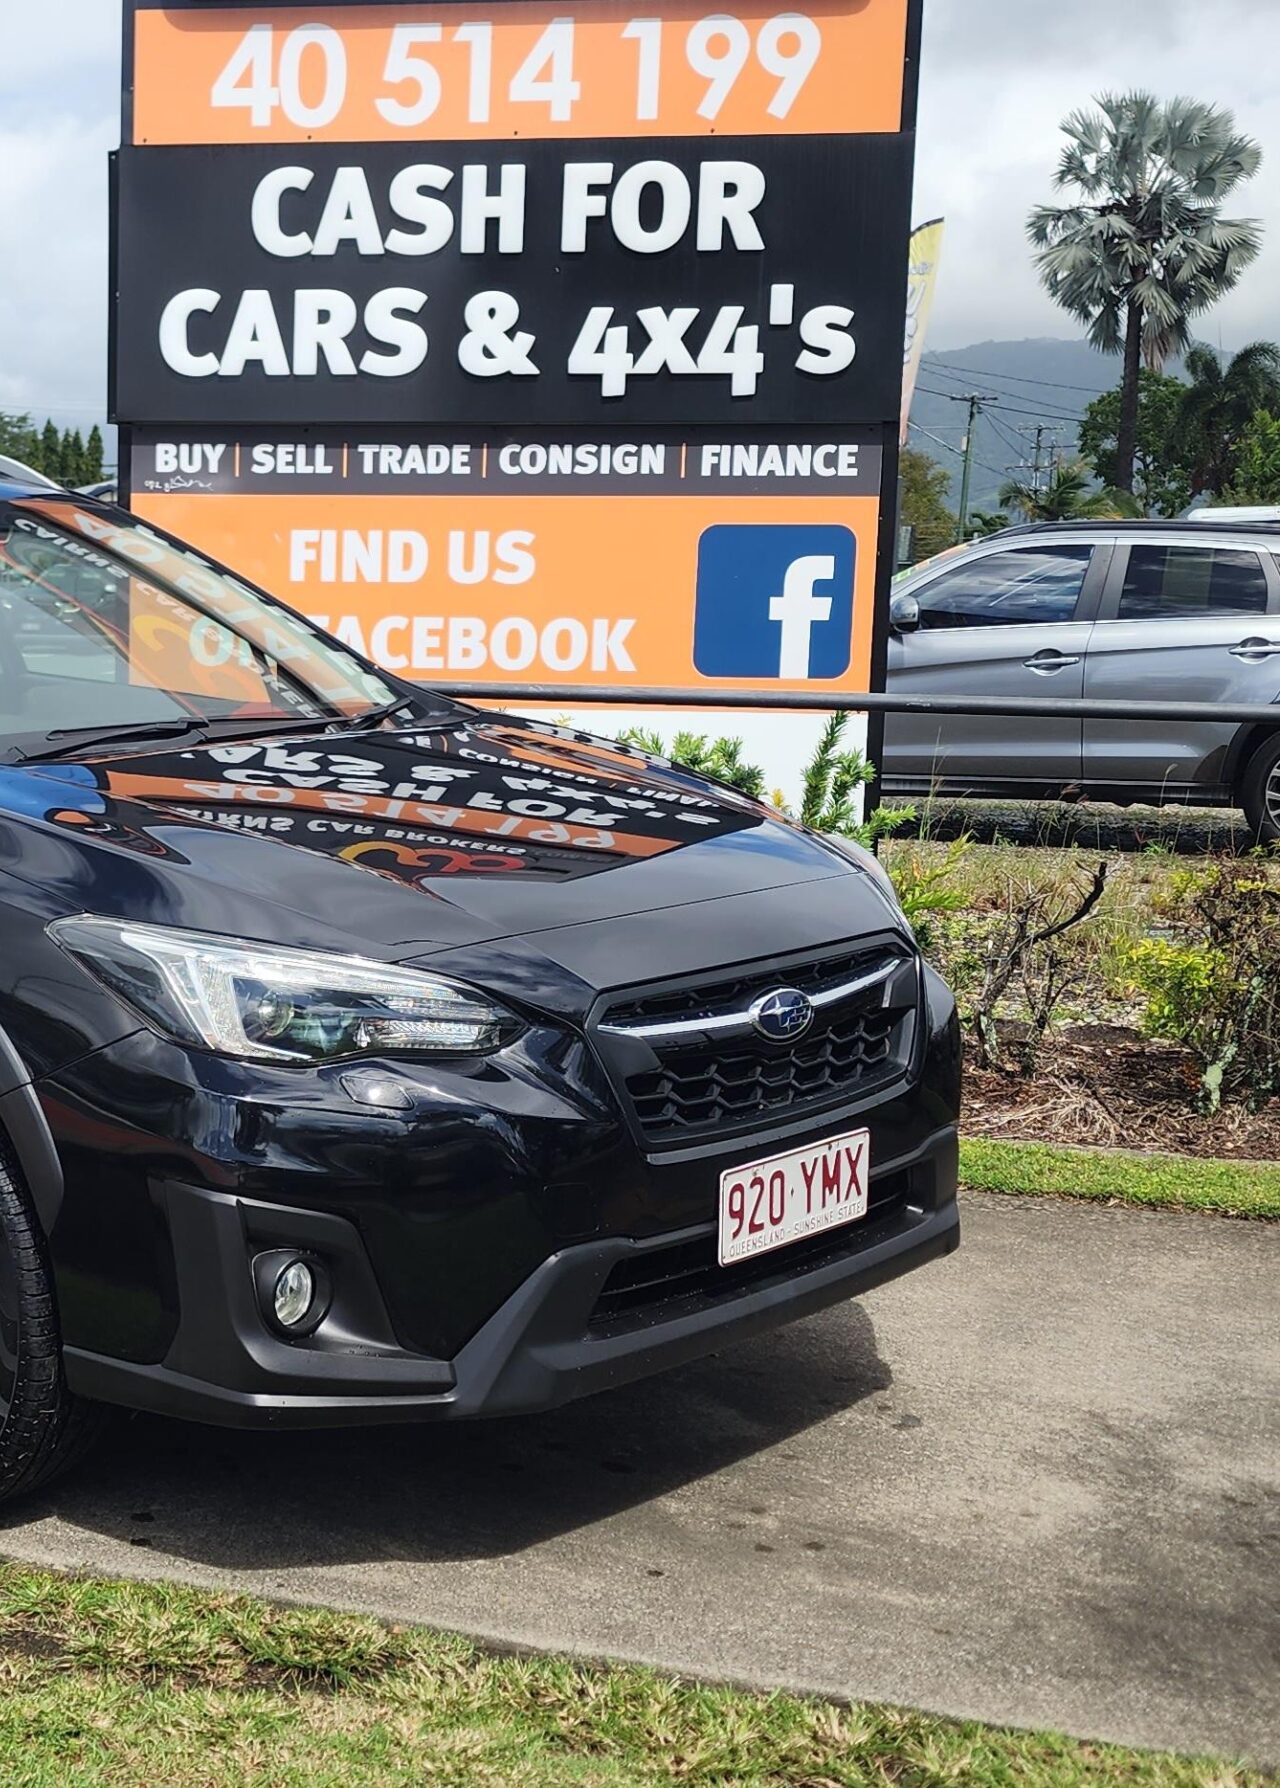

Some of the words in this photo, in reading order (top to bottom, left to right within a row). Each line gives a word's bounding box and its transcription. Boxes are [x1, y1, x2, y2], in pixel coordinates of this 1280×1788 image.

[210, 23, 348, 129] 40
[373, 18, 581, 127] 514
[621, 13, 822, 121] 199
[251, 163, 526, 258] CASH
[560, 160, 766, 253] FOR
[158, 286, 429, 377] CARS
[457, 290, 540, 377] &
[154, 442, 226, 474] BUY
[250, 443, 334, 475] SELL
[357, 444, 472, 475] TRADE
[498, 443, 666, 476] CONSIGN
[700, 444, 859, 478] FINANCE
[289, 529, 429, 584] FIND
[447, 529, 536, 585] US
[728, 1170, 785, 1241] 920
[800, 1143, 865, 1215] YMX
[729, 1229, 786, 1258] QUEENSLAND
[793, 1210, 834, 1236] SUNSHINE
[838, 1201, 863, 1220] STATE
